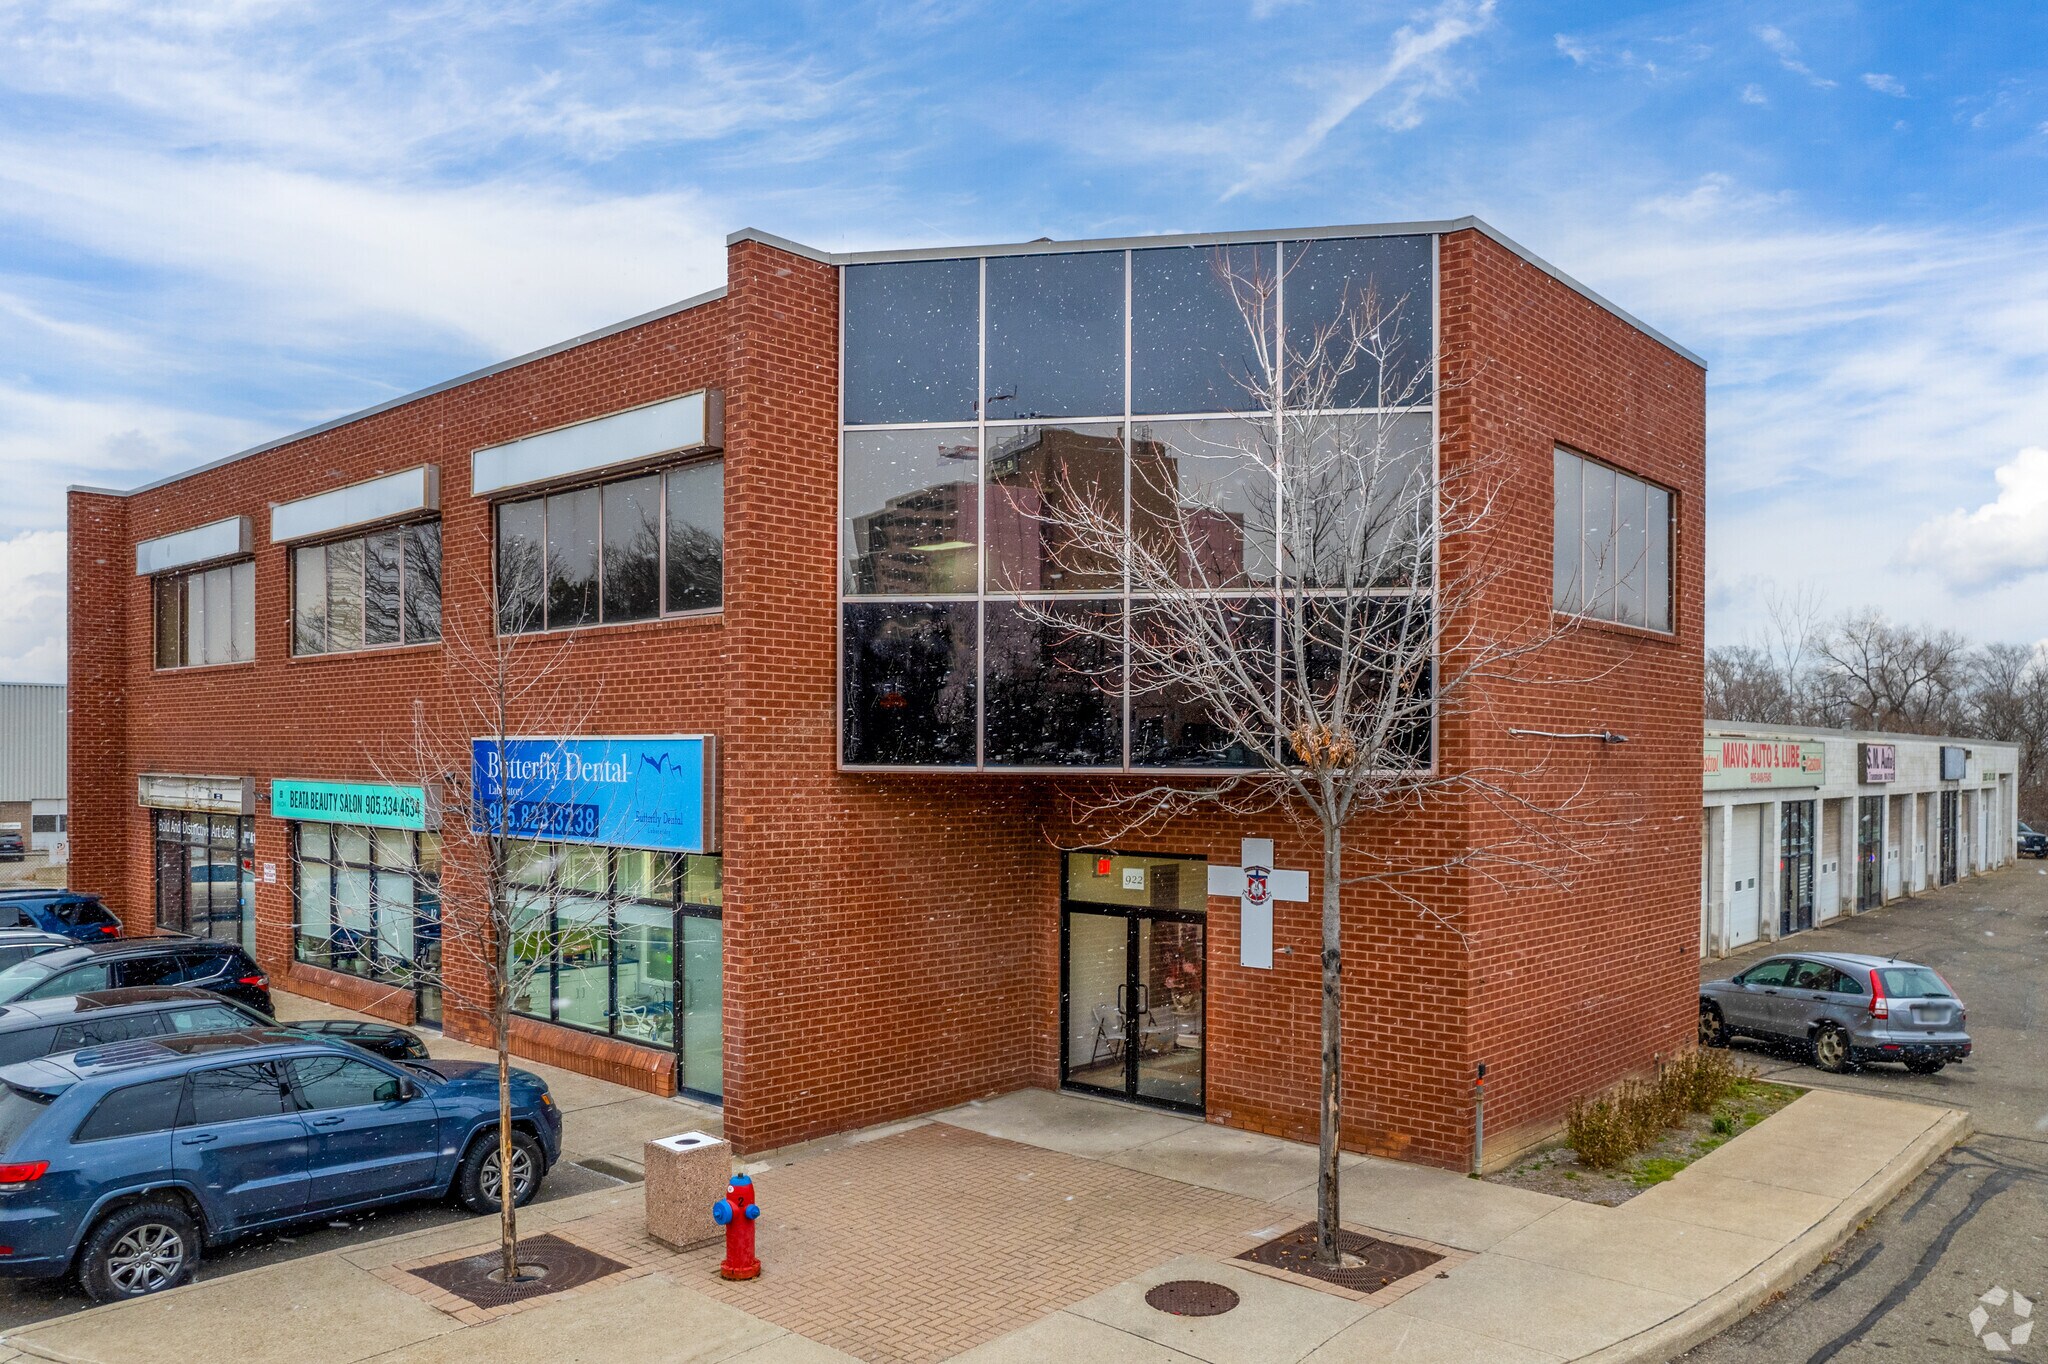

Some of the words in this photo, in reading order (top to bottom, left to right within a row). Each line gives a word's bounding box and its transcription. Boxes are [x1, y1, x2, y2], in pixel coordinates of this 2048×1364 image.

[1722, 742, 1749, 769] MAVIS
[1751, 743, 1772, 769] AUTO
[1774, 744, 1780, 768] &
[1782, 744, 1800, 769] LUBE
[290, 790, 309, 809] BEATA
[311, 791, 338, 811] BEAUTY
[340, 793, 362, 814] SALON
[1125, 875, 1143, 886] 922
[738, 1196, 745, 1208] 2
